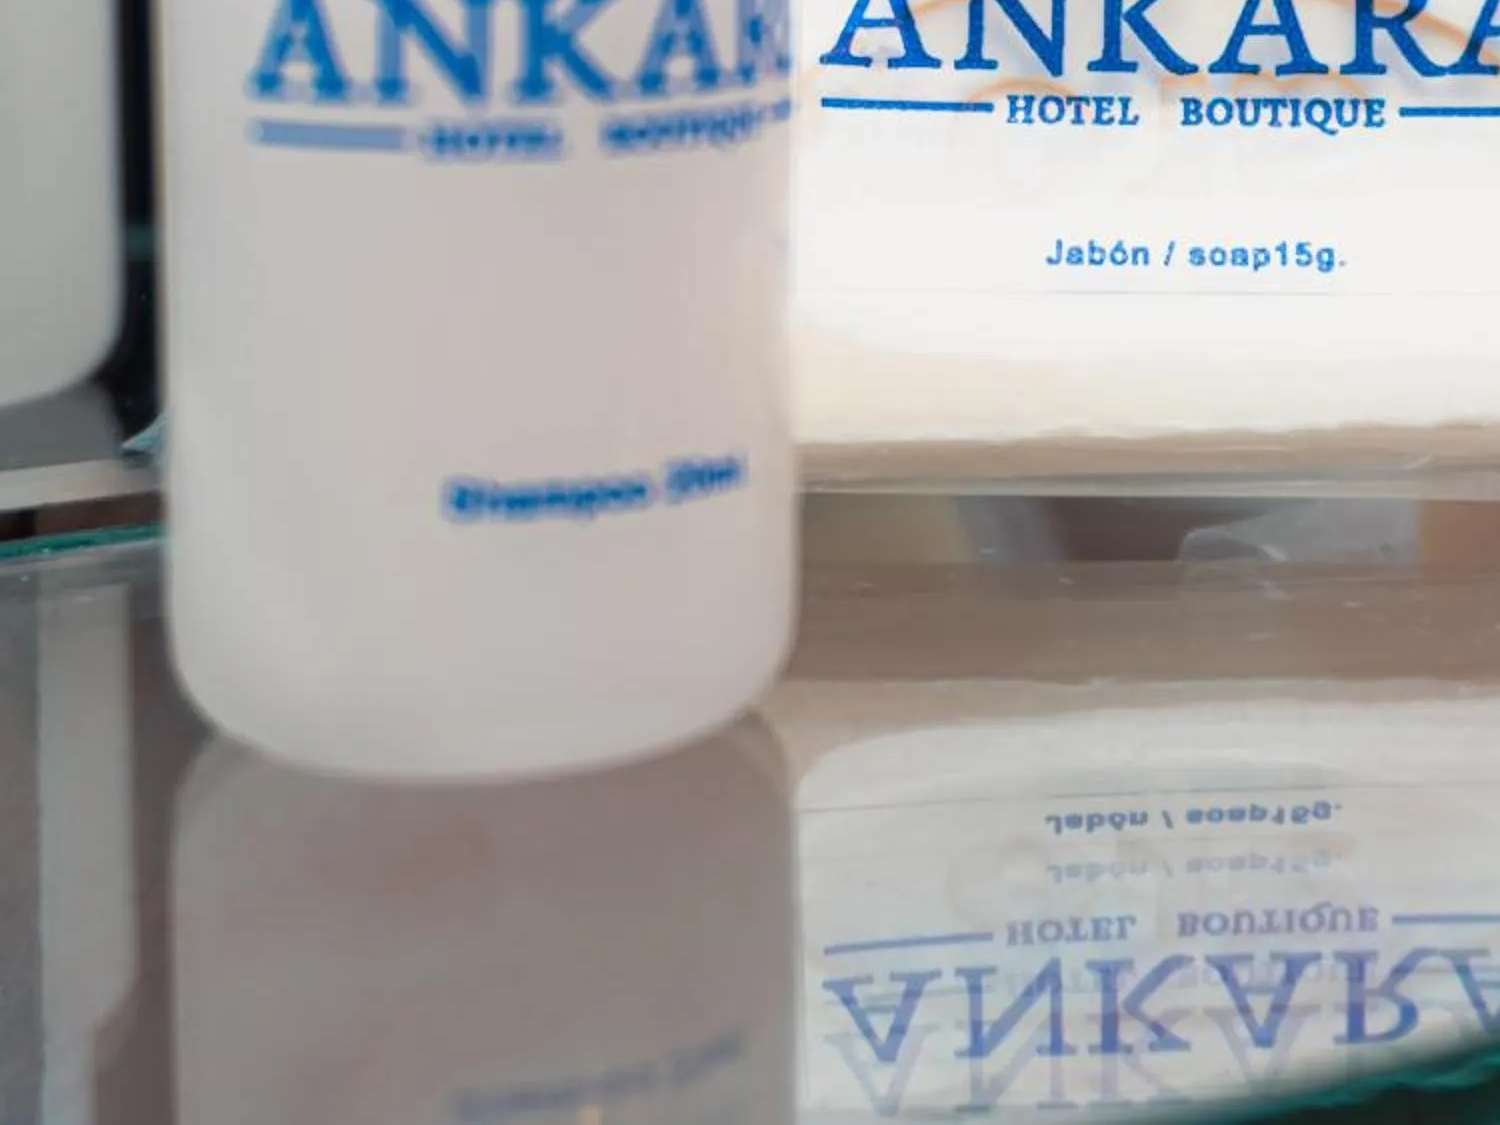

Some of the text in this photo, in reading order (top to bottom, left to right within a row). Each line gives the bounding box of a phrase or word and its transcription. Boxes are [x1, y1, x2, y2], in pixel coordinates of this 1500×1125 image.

[1006, 94, 1386, 136] HOTEL BOUTIQUE
[1046, 239, 1347, 273] Jabón / soap15g.
